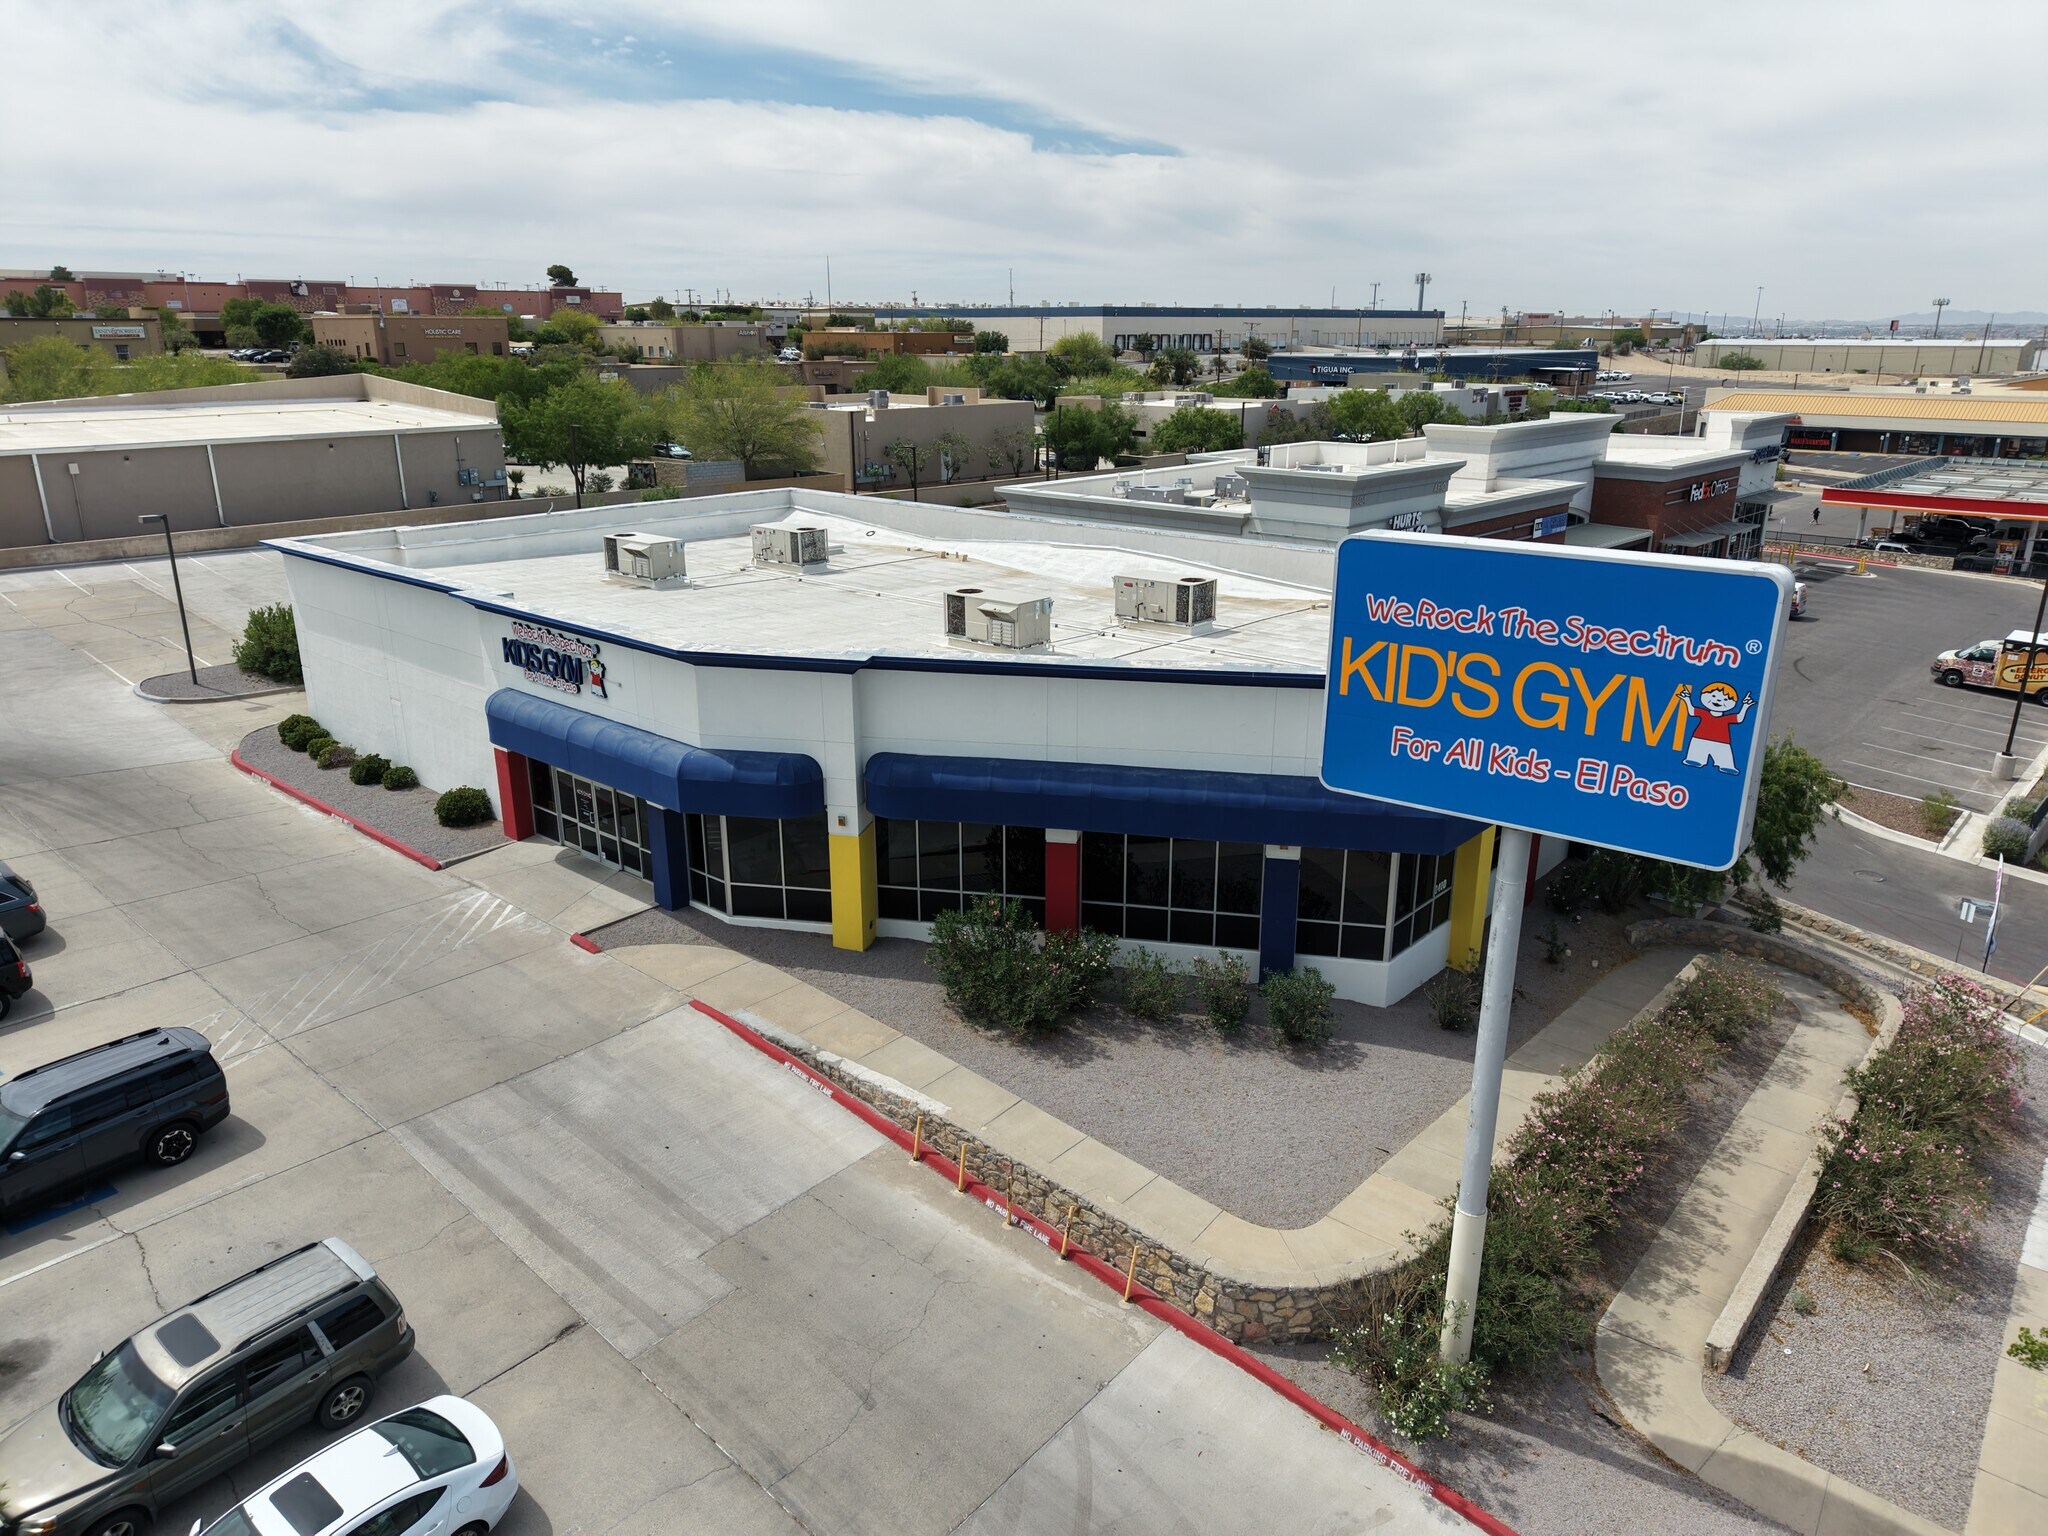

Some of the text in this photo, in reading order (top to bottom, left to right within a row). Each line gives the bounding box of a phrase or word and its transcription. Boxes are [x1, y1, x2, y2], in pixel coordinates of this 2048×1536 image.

[1340, 366, 1355, 374] INC.
[1690, 480, 1729, 502] FedEx Office
[1392, 511, 1423, 530] HURTS
[554, 633, 593, 659] Spectrum
[1366, 594, 1415, 627] We
[1416, 598, 1493, 636] Rock
[1501, 607, 1559, 645] The
[1561, 615, 1741, 668] Spectrum
[542, 648, 584, 686] GYM
[1339, 637, 1693, 752] KID'S GYM
[1391, 726, 1439, 762] For
[1445, 738, 1482, 771] All
[1488, 743, 1550, 783] Kids
[1576, 759, 1607, 793] El
[1612, 766, 1689, 810] Paso
[784, 1061, 834, 1098] NO PARKING FIRE LANE
[985, 1197, 1050, 1246] NO PARNG FIRE LANE
[1340, 1428, 1434, 1497] NO PARKING FIRE LANE
